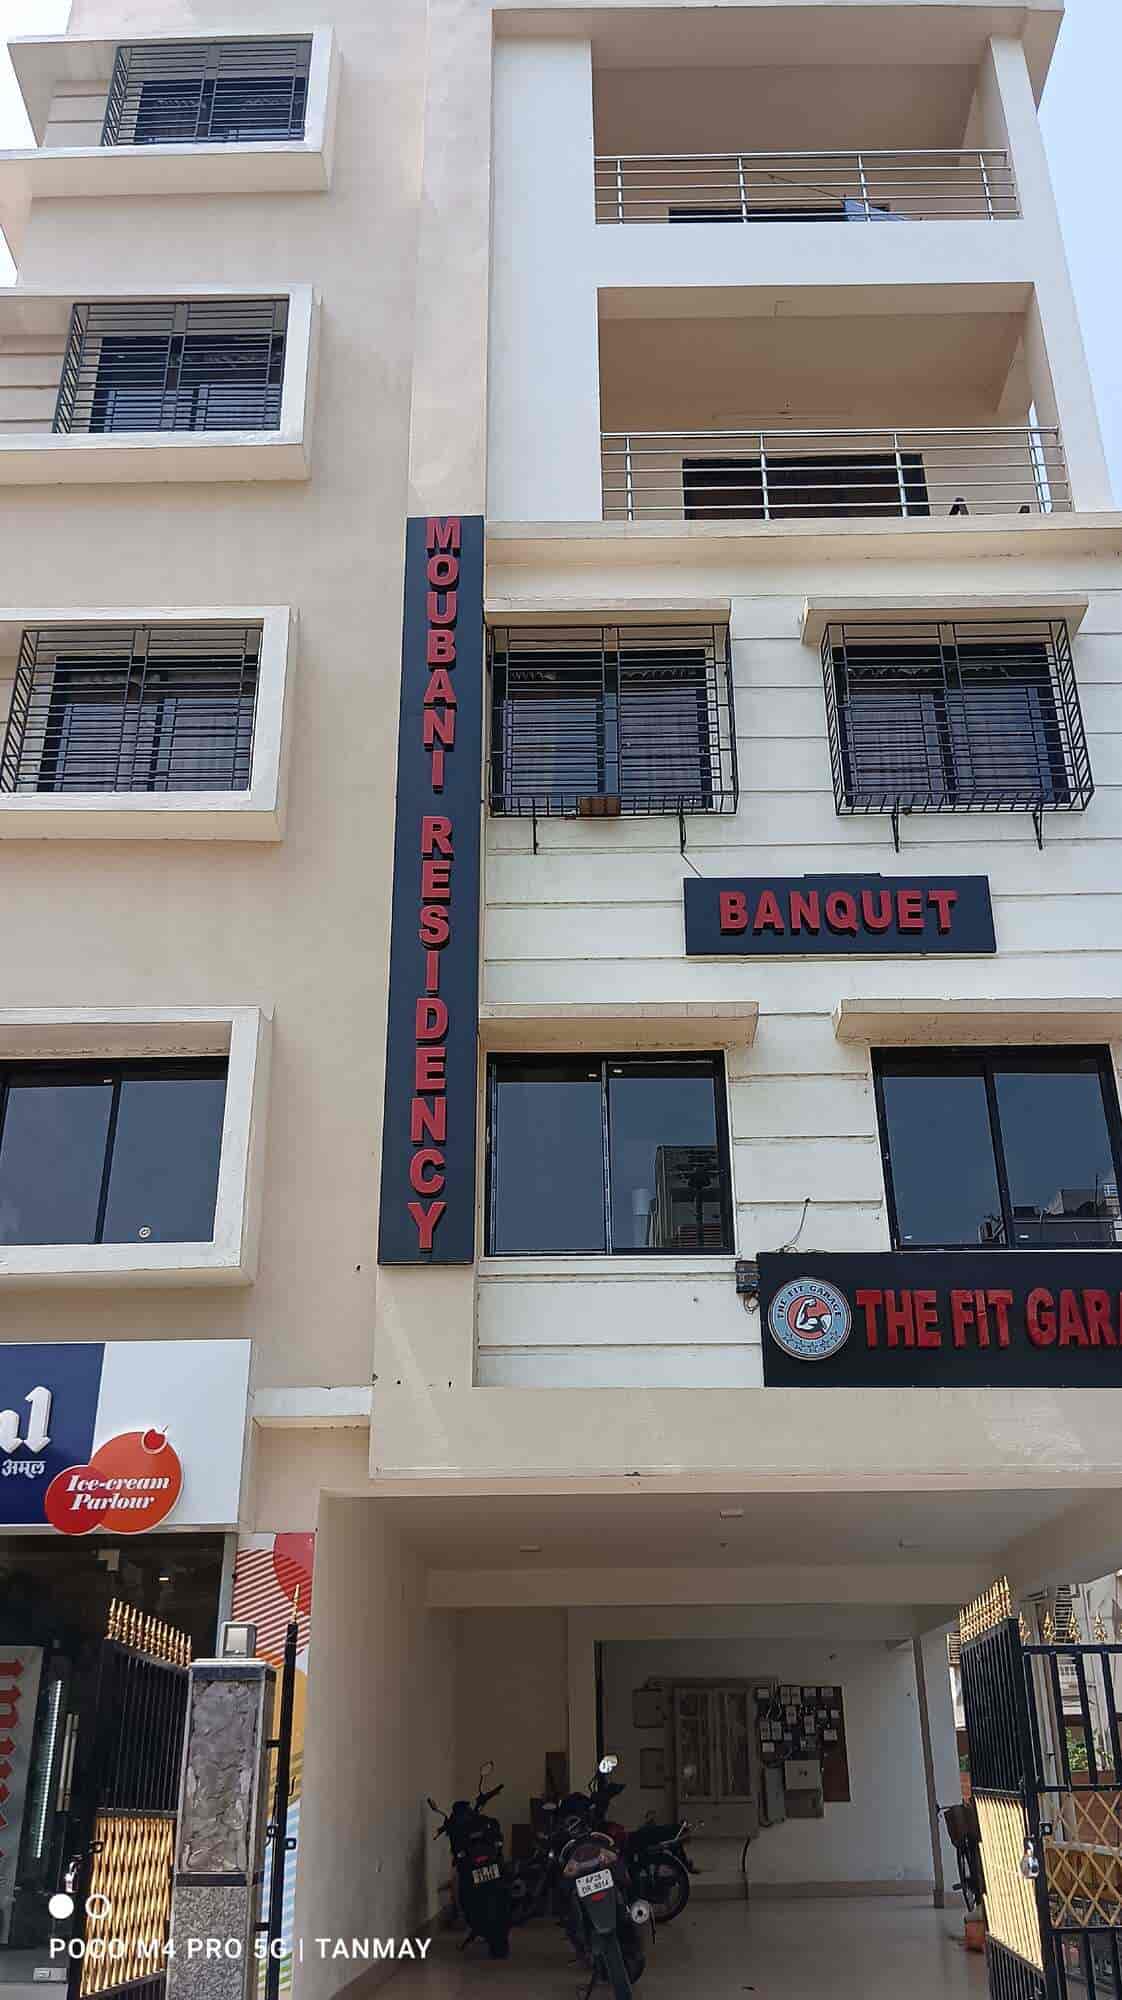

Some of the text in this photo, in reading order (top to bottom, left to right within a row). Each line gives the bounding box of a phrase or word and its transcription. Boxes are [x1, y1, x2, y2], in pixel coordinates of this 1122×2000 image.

[408, 516, 461, 1251] MOUBANI RESIDENCY
[719, 890, 957, 934] BANQUET
[856, 1289, 942, 1349] THE
[951, 1289, 1014, 1348] FIT
[1026, 1287, 1122, 1346] GAR
[66, 1475, 170, 1491] Ice-cream
[69, 1493, 155, 1510] Parlour
